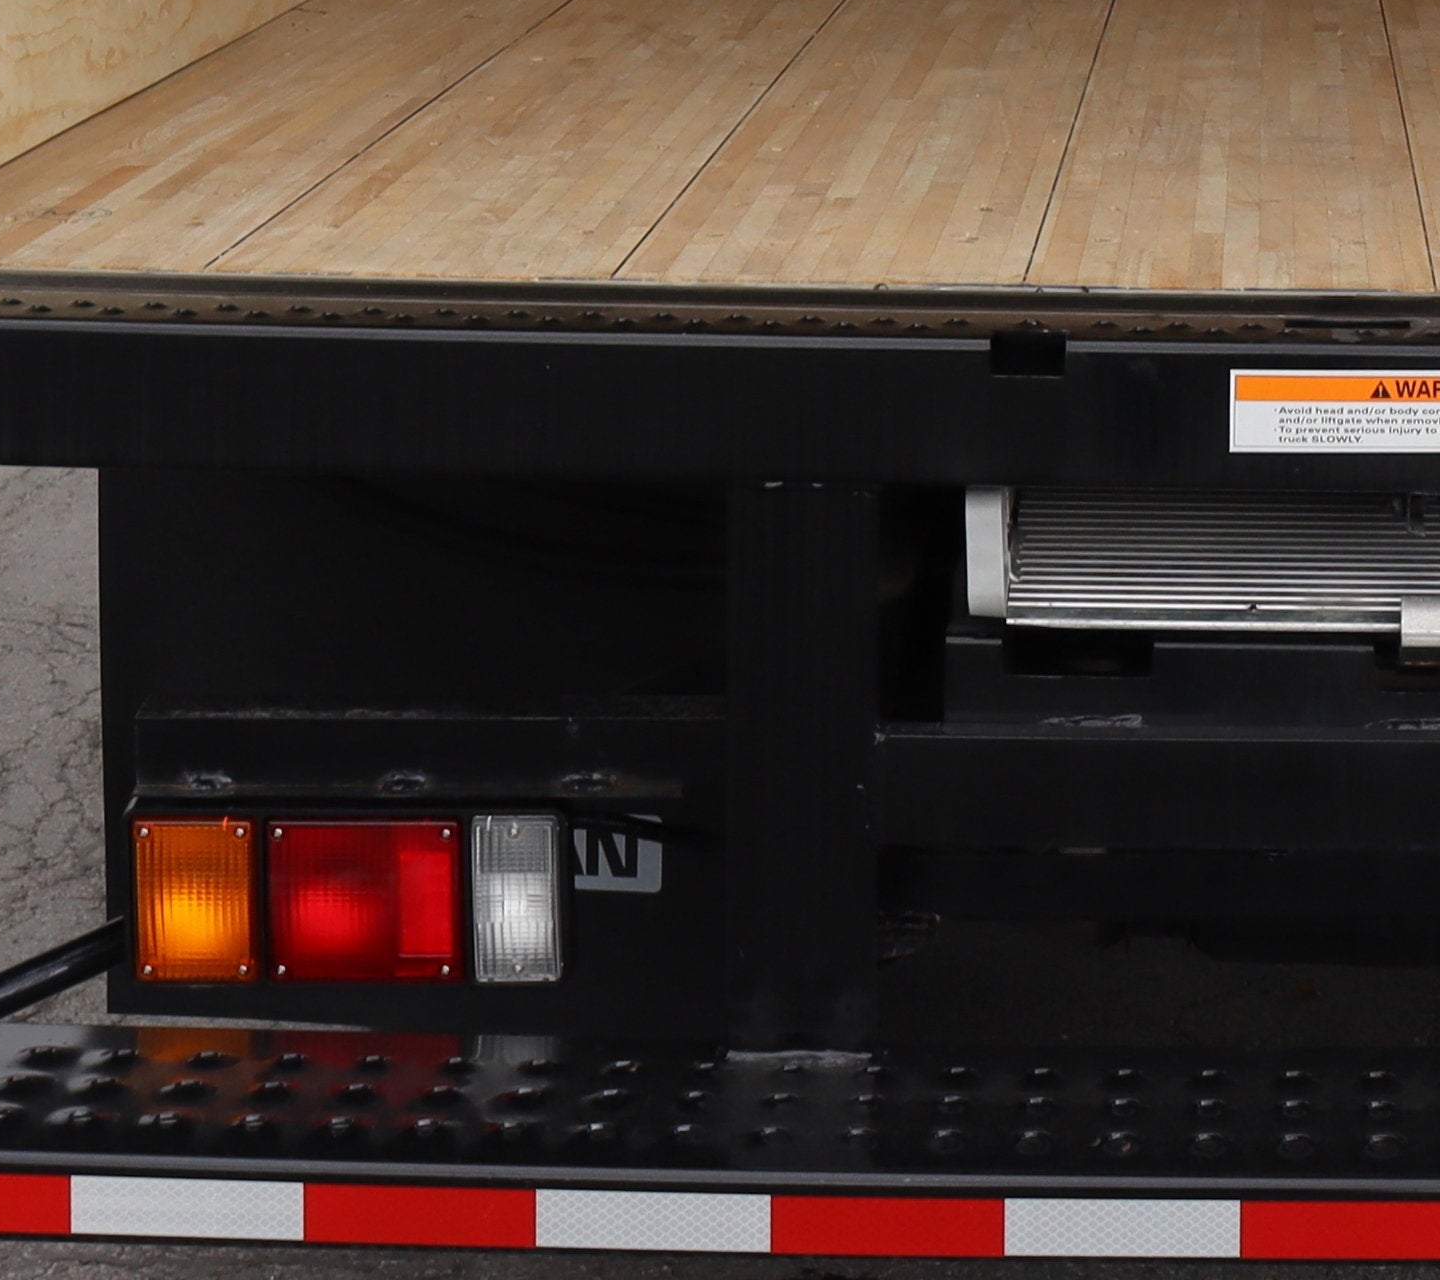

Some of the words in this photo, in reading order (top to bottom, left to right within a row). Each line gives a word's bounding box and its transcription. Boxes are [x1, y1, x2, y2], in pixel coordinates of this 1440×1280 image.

[1279, 406, 1312, 415] Avoid
[1316, 406, 1344, 415] head
[1347, 406, 1386, 415] and/or
[1390, 407, 1419, 416] body
[1279, 416, 1317, 425] and/or
[1321, 416, 1363, 426] liftgate
[1366, 417, 1398, 425] when
[1279, 426, 1293, 434] To
[1295, 427, 1340, 435] prevent
[1344, 426, 1386, 434] serious
[1389, 426, 1422, 435] injury
